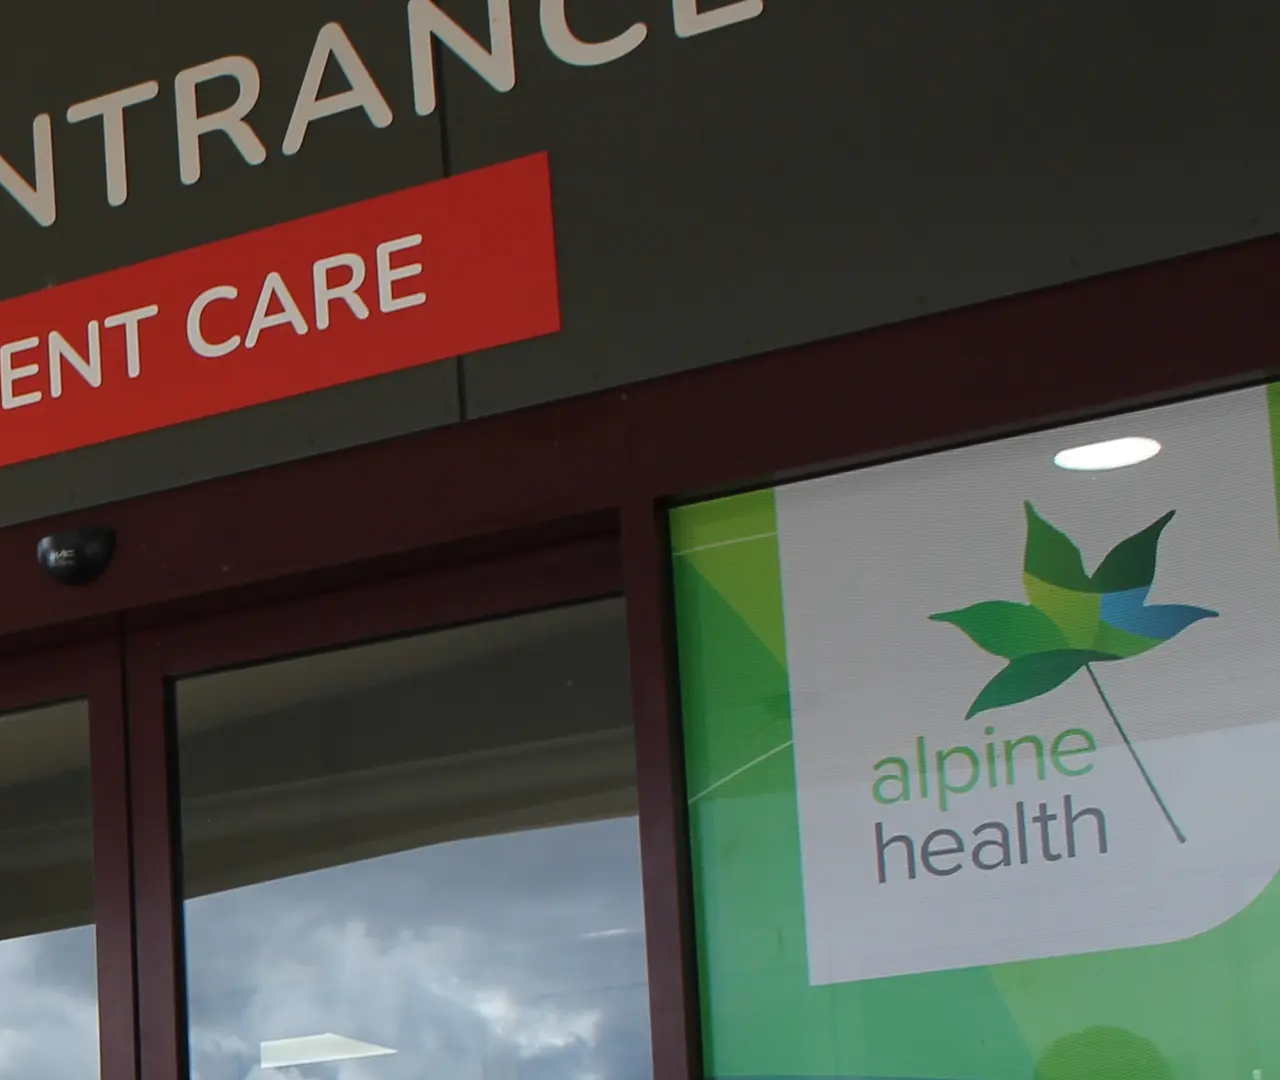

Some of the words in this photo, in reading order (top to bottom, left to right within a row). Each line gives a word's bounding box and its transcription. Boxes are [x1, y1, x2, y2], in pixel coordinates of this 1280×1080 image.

[186, 233, 427, 359] CARE
[871, 726, 1097, 812] alpine
[873, 794, 1108, 884] health
